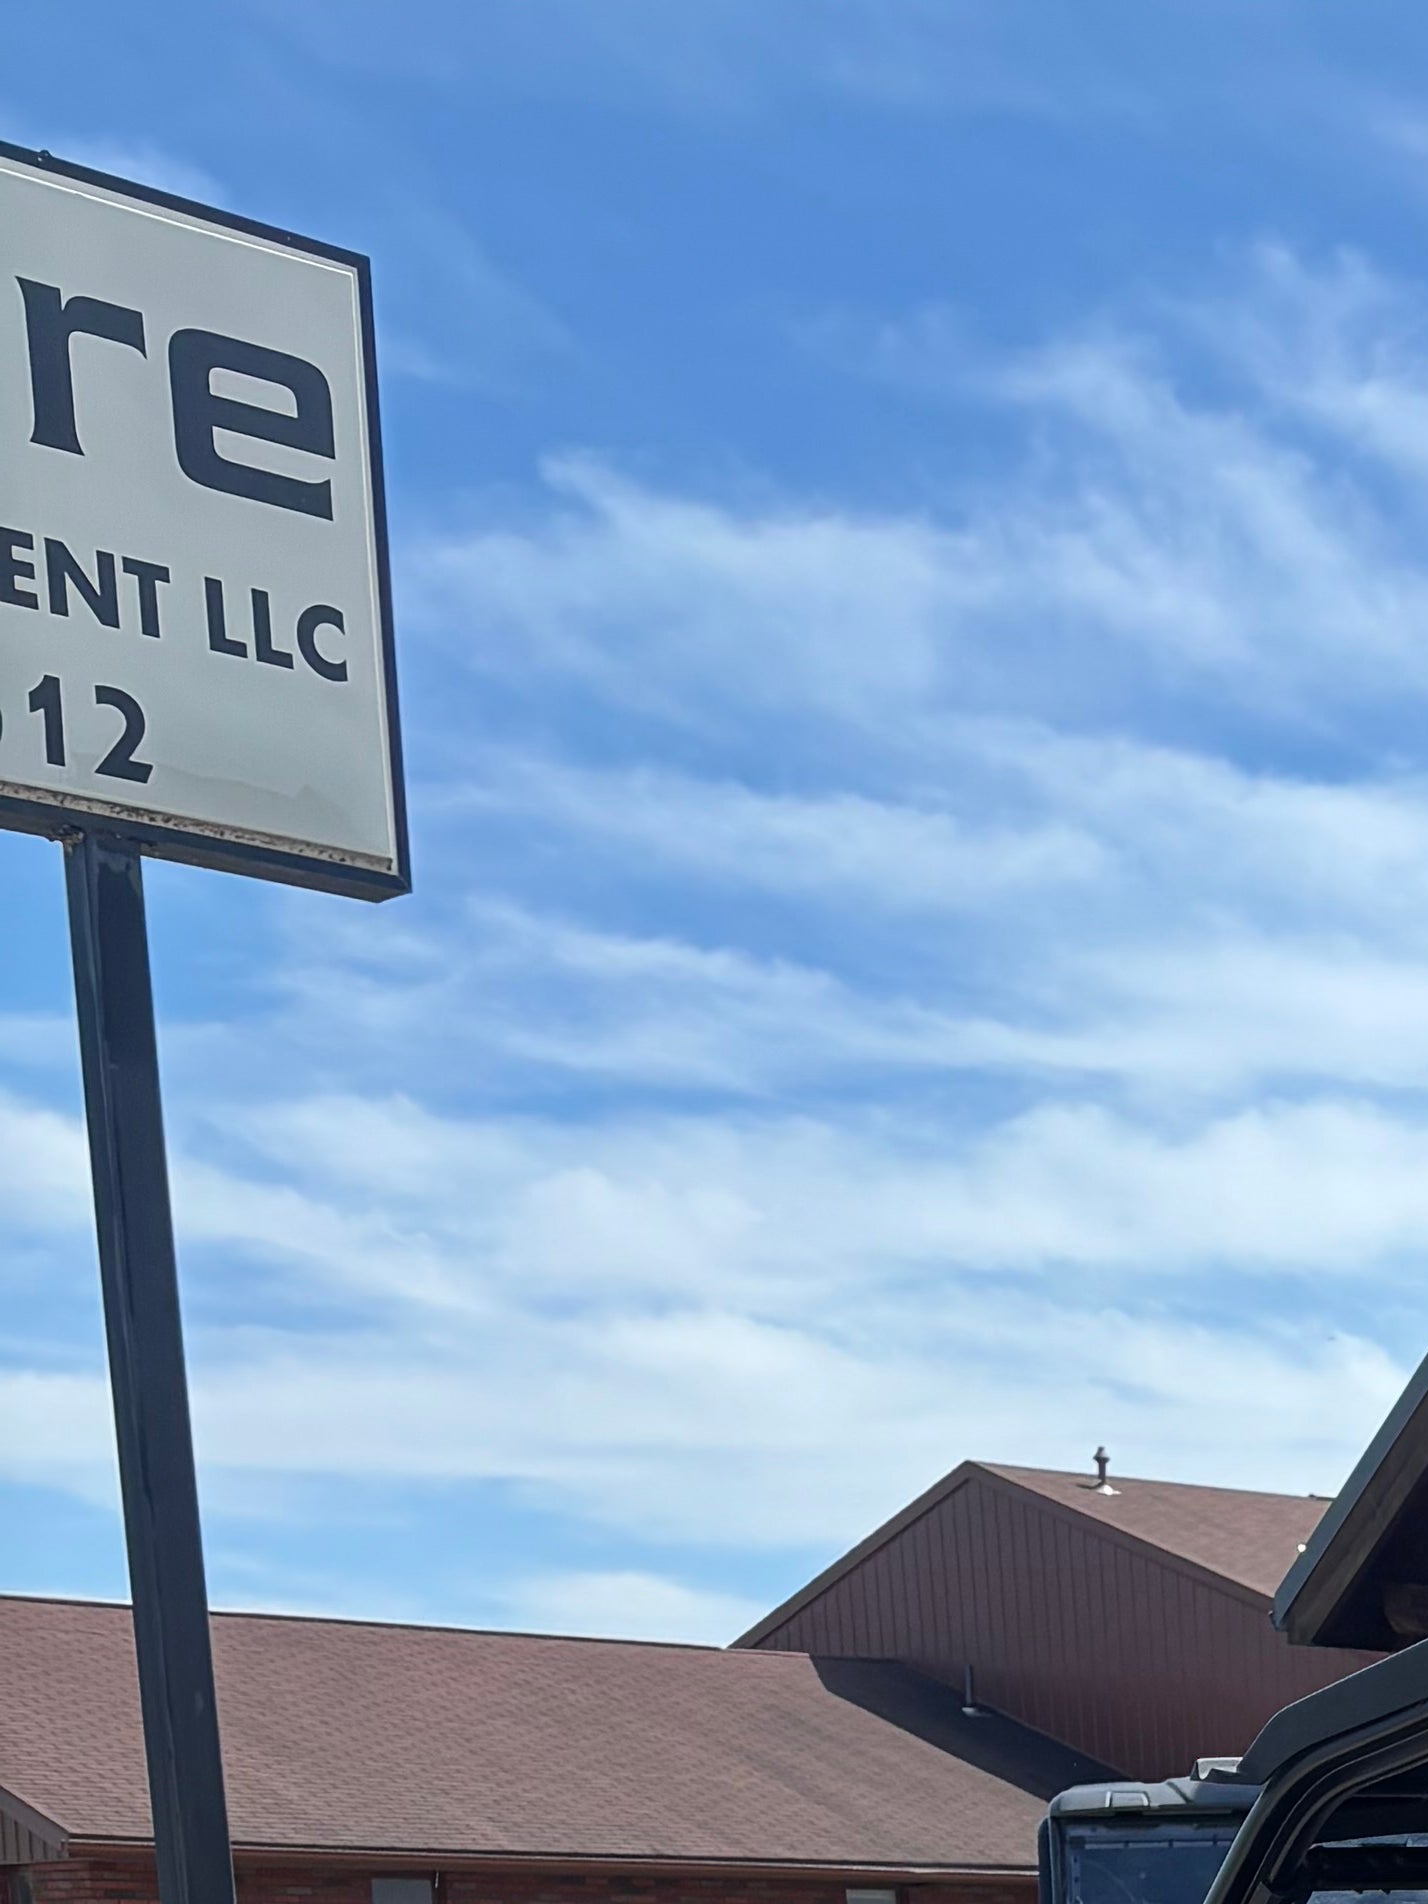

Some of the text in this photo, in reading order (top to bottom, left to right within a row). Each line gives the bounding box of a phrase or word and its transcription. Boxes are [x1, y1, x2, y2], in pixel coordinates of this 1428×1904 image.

[15, 275, 337, 522] re
[0, 526, 349, 682] ENT LLC
[0, 675, 154, 784] 12
